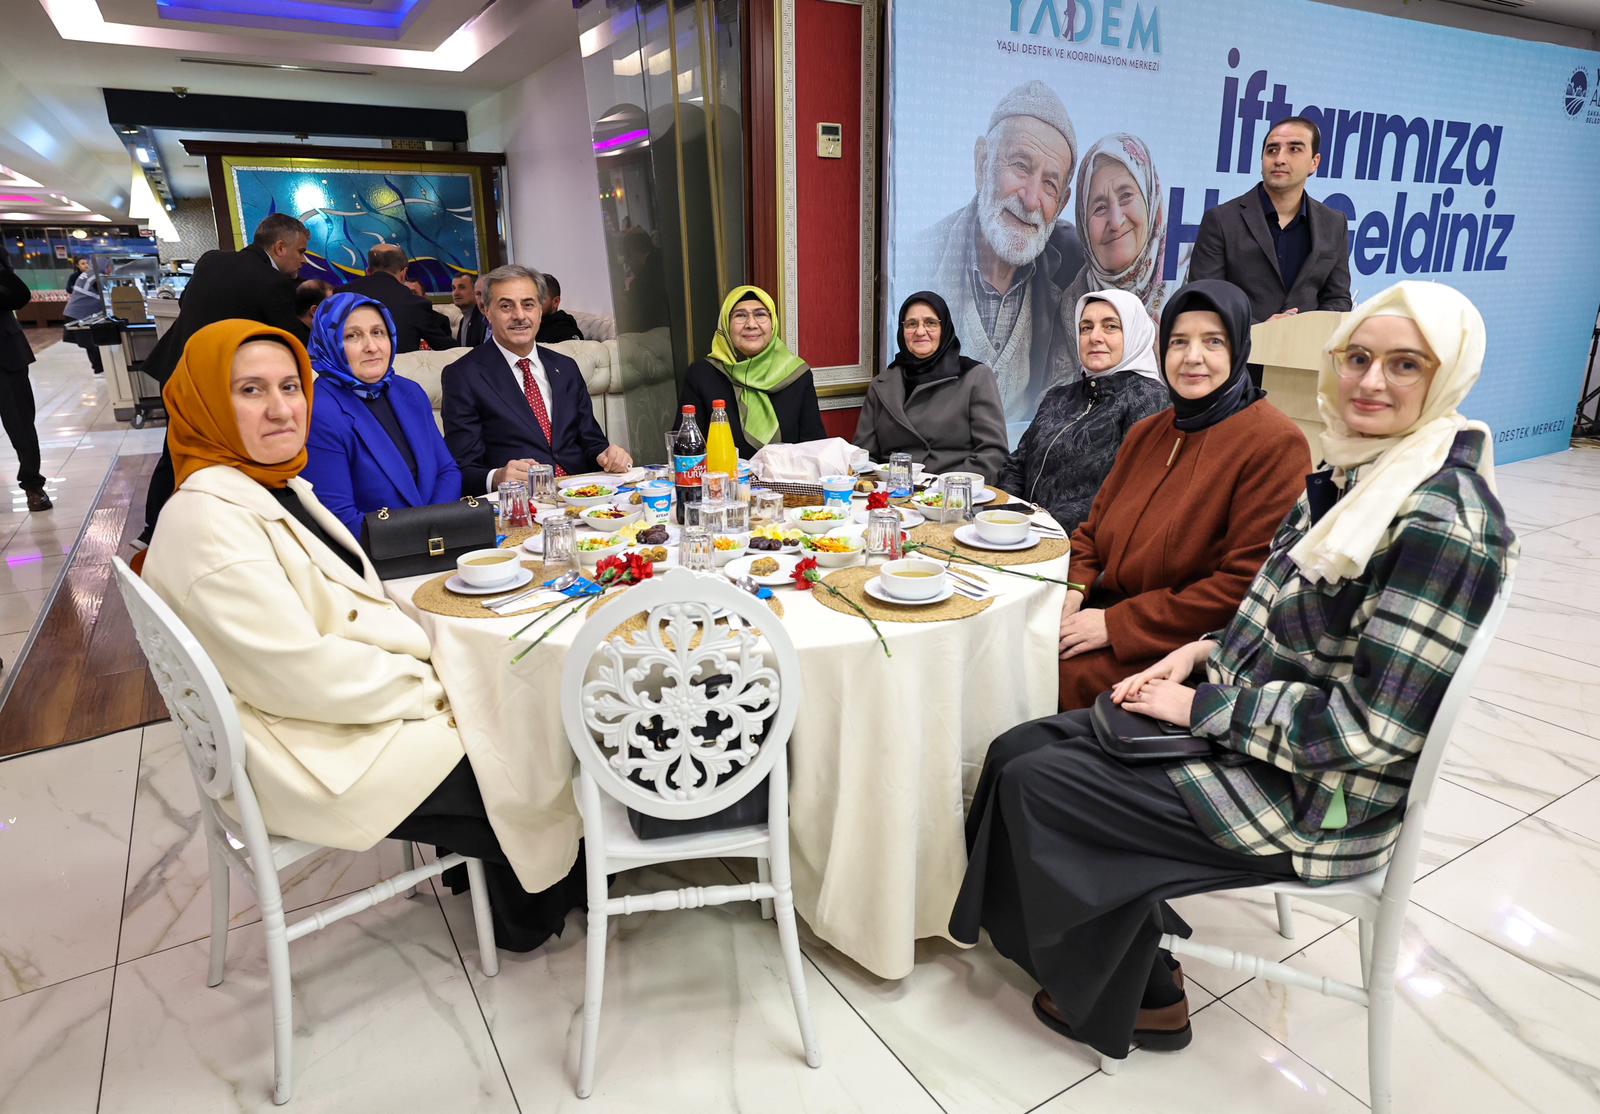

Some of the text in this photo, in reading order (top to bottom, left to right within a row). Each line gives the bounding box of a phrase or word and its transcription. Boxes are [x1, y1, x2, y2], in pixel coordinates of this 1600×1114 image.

[1007, 0, 1160, 53] YADEM
[996, 39, 1160, 72] YAŞLI DESTEK VE KOORDİNASYON MERKEZİ
[1499, 427, 1530, 443] DESTEK
